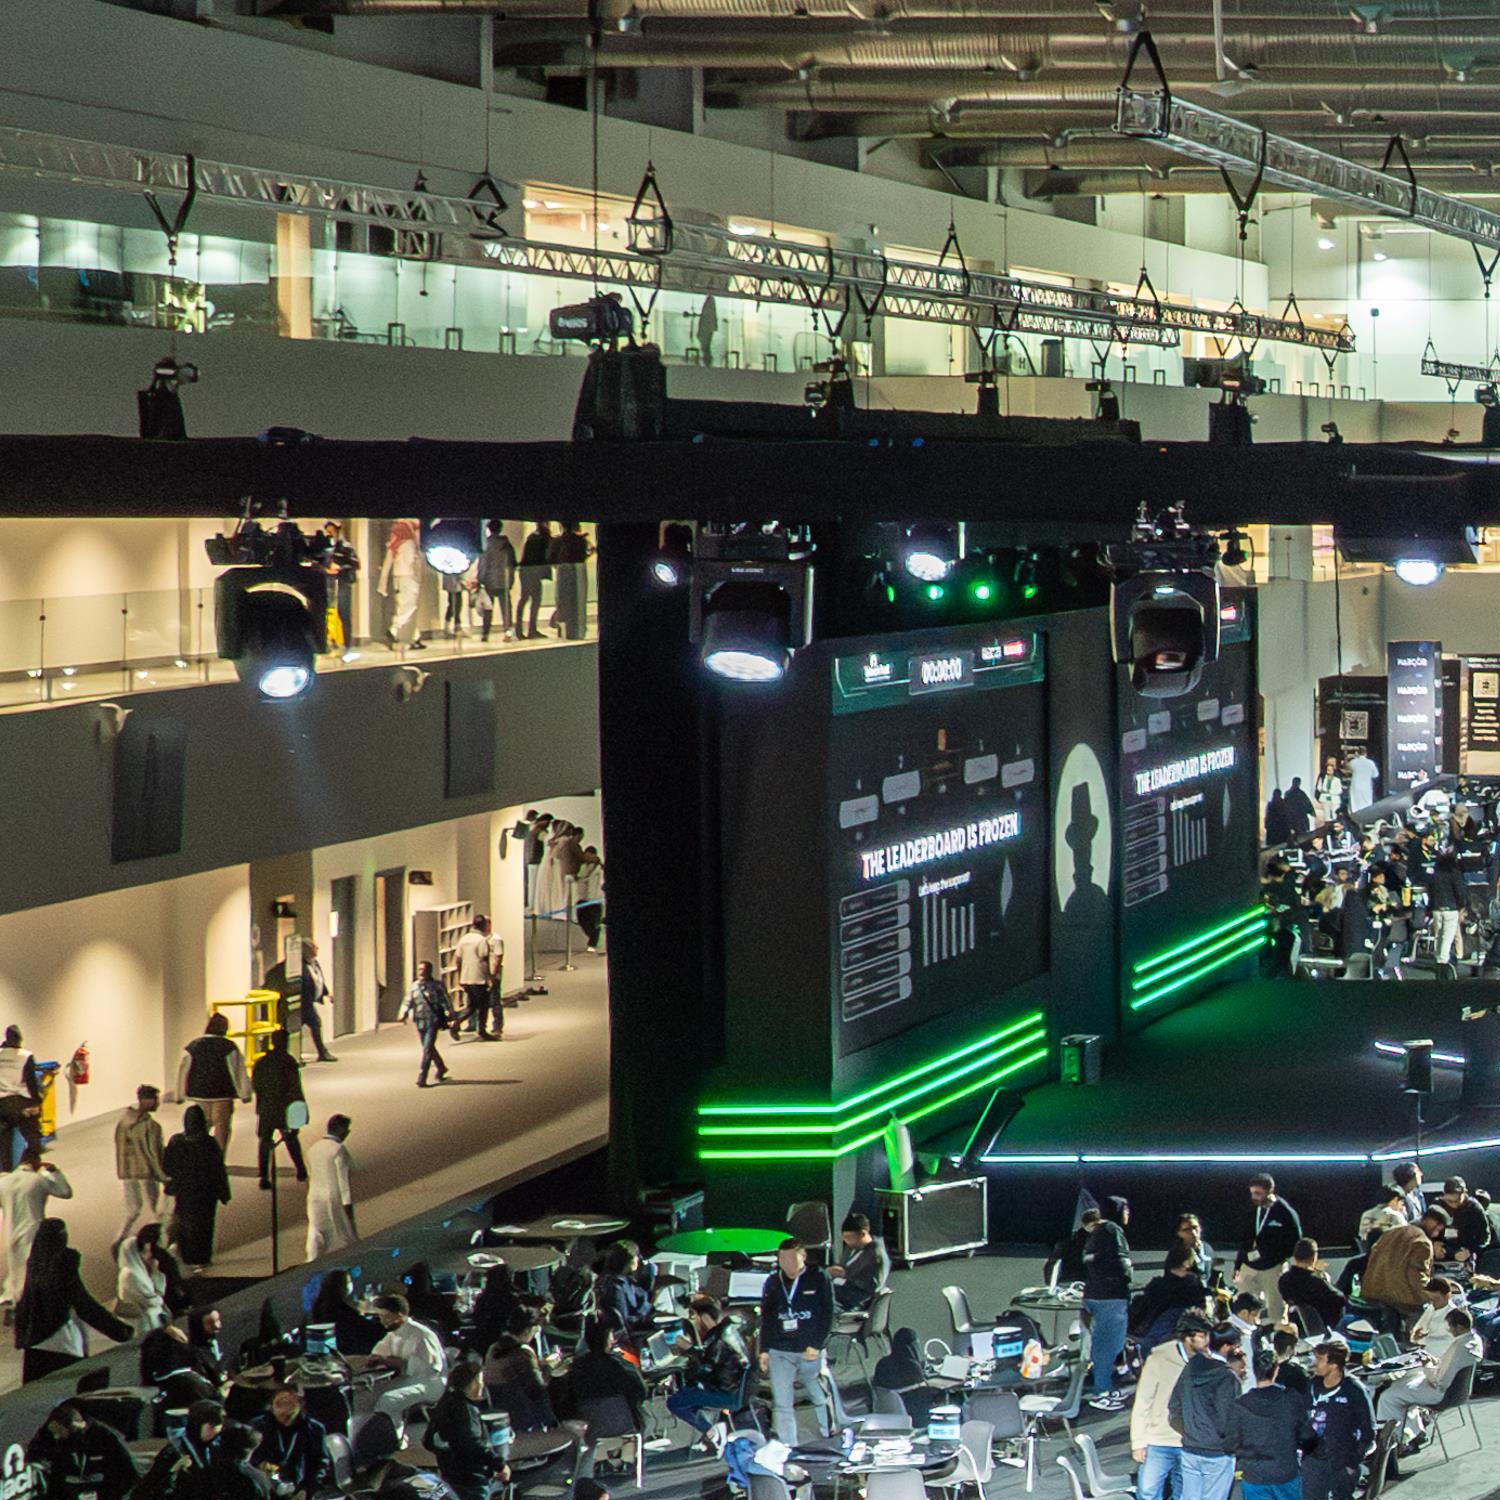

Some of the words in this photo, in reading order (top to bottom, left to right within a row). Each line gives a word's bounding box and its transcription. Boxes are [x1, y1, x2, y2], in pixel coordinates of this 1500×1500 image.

[861, 850, 885, 880] THE
[886, 827, 966, 873] LEADERBOARD
[966, 823, 978, 849] IS
[978, 811, 1018, 847] FROZEN
